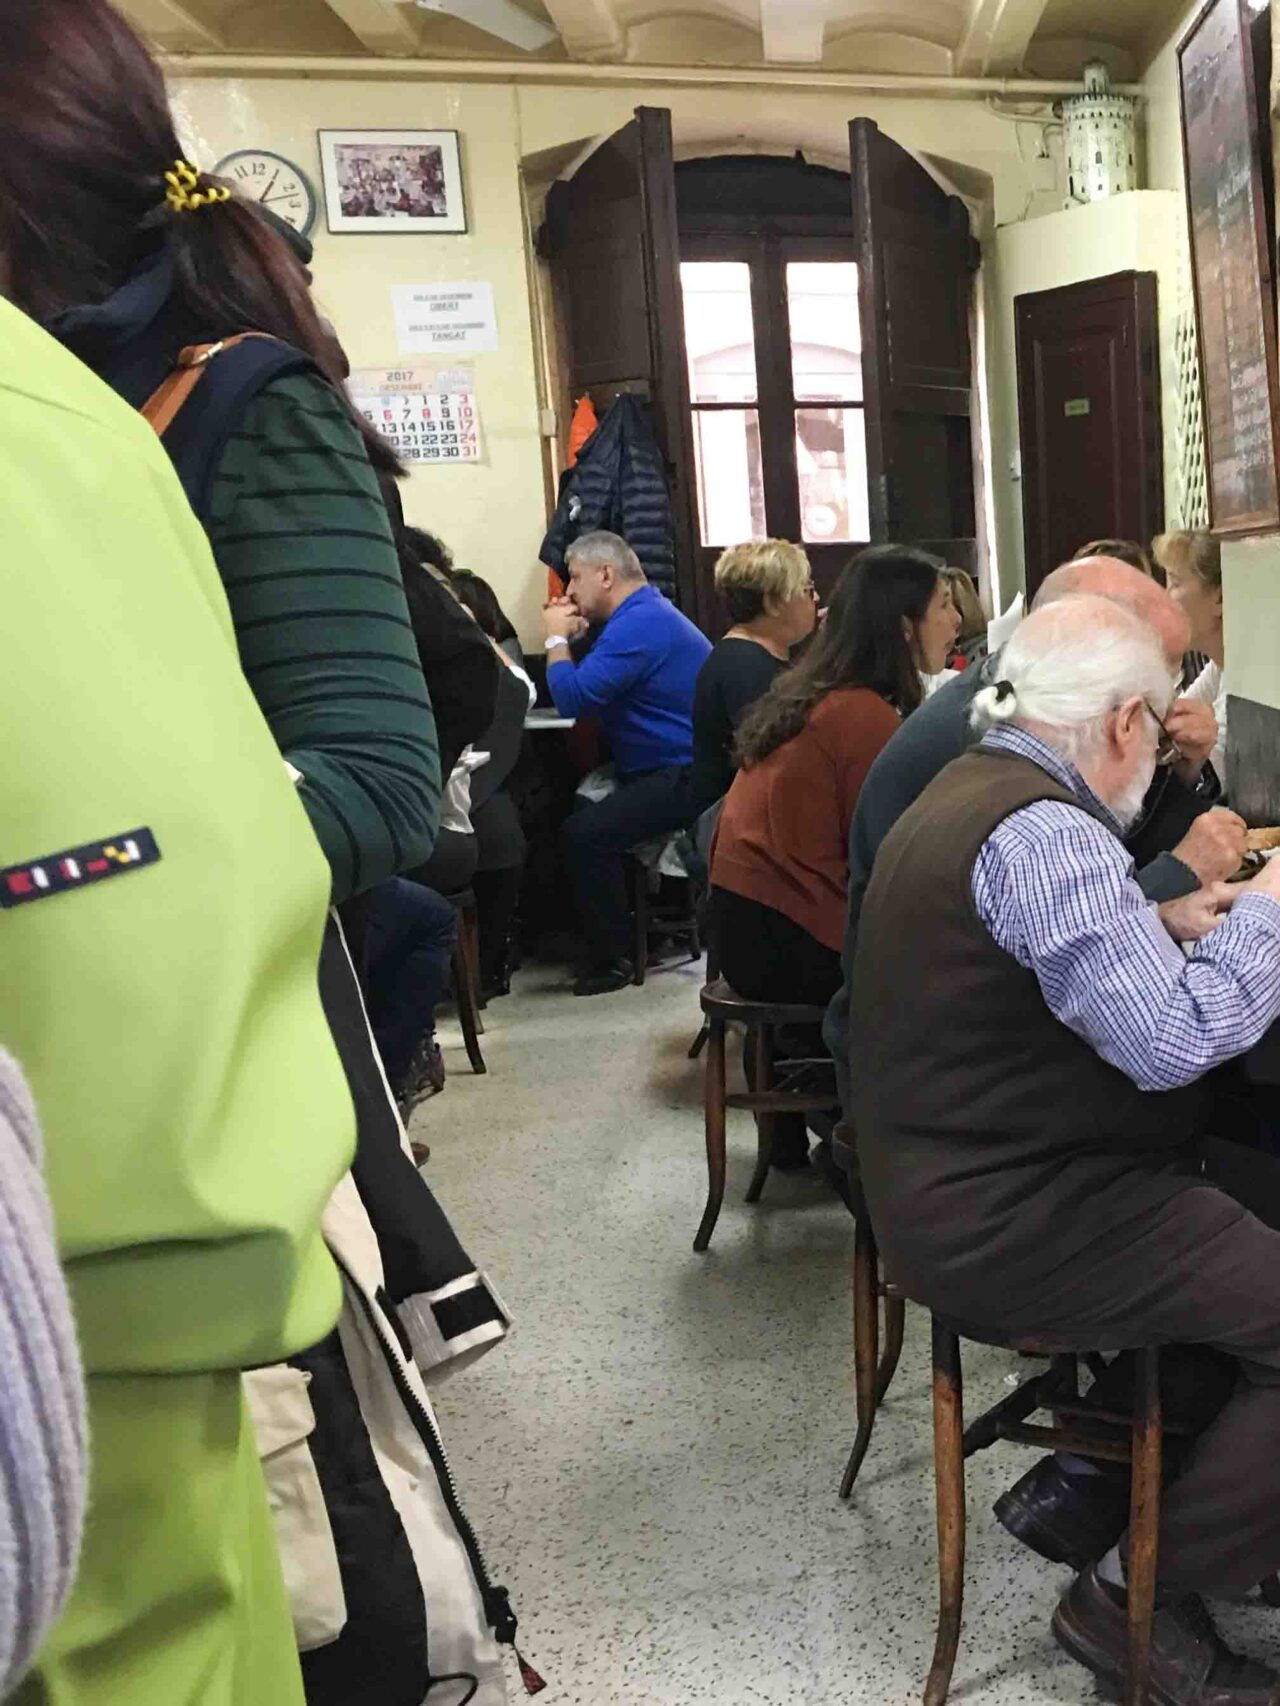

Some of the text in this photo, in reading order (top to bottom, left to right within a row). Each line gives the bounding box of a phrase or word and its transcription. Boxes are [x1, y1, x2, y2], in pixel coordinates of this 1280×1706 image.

[234, 165, 249, 179] 11
[252, 162, 266, 176] 12
[283, 182, 296, 193] 2
[288, 200, 302, 209] 3
[386, 371, 415, 382] 2017
[422, 393, 468, 406] 1 2 3
[383, 409, 392, 421] 6
[402, 409, 412, 419] 7
[422, 407, 432, 418] 8
[441, 407, 451, 418] 9
[458, 406, 473, 418] 10
[381, 419, 474, 434] 13 14 15 16 17
[402, 434, 419, 446] 21
[421, 434, 438, 445] 22
[440, 433, 458, 445] 23
[459, 432, 477, 444] 24
[403, 445, 477, 459] 28 29 30 31
